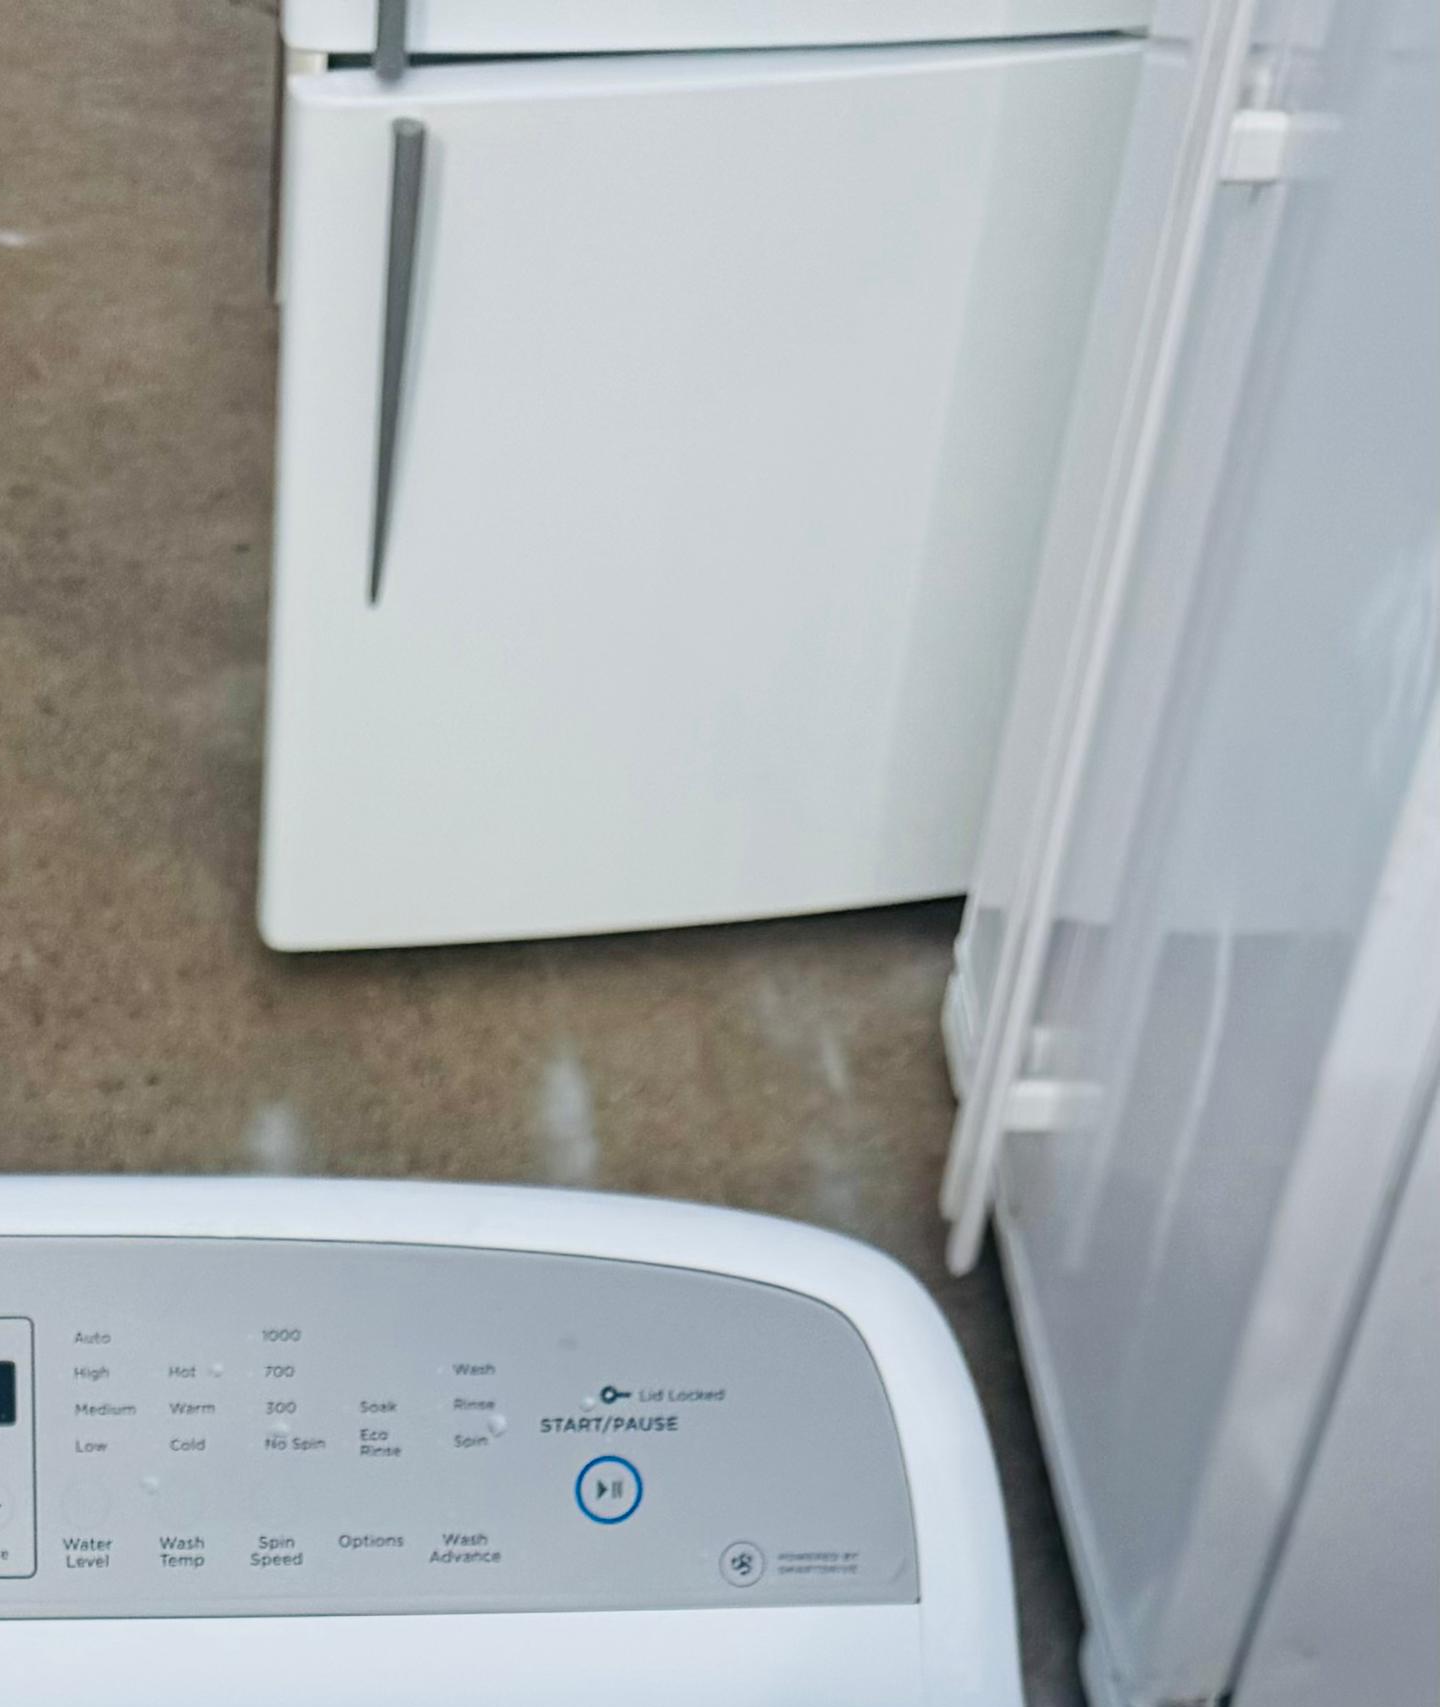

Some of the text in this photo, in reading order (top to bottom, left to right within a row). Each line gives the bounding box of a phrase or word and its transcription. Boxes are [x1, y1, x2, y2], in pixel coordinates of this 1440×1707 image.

[74, 1332, 111, 1345] Auto
[262, 1328, 301, 1342] 1000
[74, 1366, 110, 1381] High
[169, 1366, 197, 1378] Hot
[265, 1364, 295, 1378] 700
[453, 1363, 495, 1376] Wash
[638, 1389, 725, 1401] Lid Locked
[75, 1403, 136, 1416] Medium
[170, 1402, 215, 1414] Warm
[265, 1401, 296, 1414] 300
[360, 1400, 397, 1413] Soak
[540, 1417, 678, 1432] START/PAUSE
[360, 1428, 388, 1441] Eco
[454, 1434, 488, 1448] Spin
[75, 1440, 107, 1452] Low
[170, 1437, 206, 1451] Cold
[265, 1437, 326, 1452] No Spin
[360, 1445, 401, 1457] Rinse
[62, 1537, 112, 1551] Water
[160, 1535, 204, 1550] Wash
[258, 1535, 295, 1551] Spin
[338, 1534, 404, 1550] Options
[442, 1532, 488, 1546] Wash
[66, 1554, 109, 1569] Level
[160, 1554, 204, 1569] Temp
[250, 1552, 303, 1568] Speed
[429, 1549, 501, 1564] Advance
